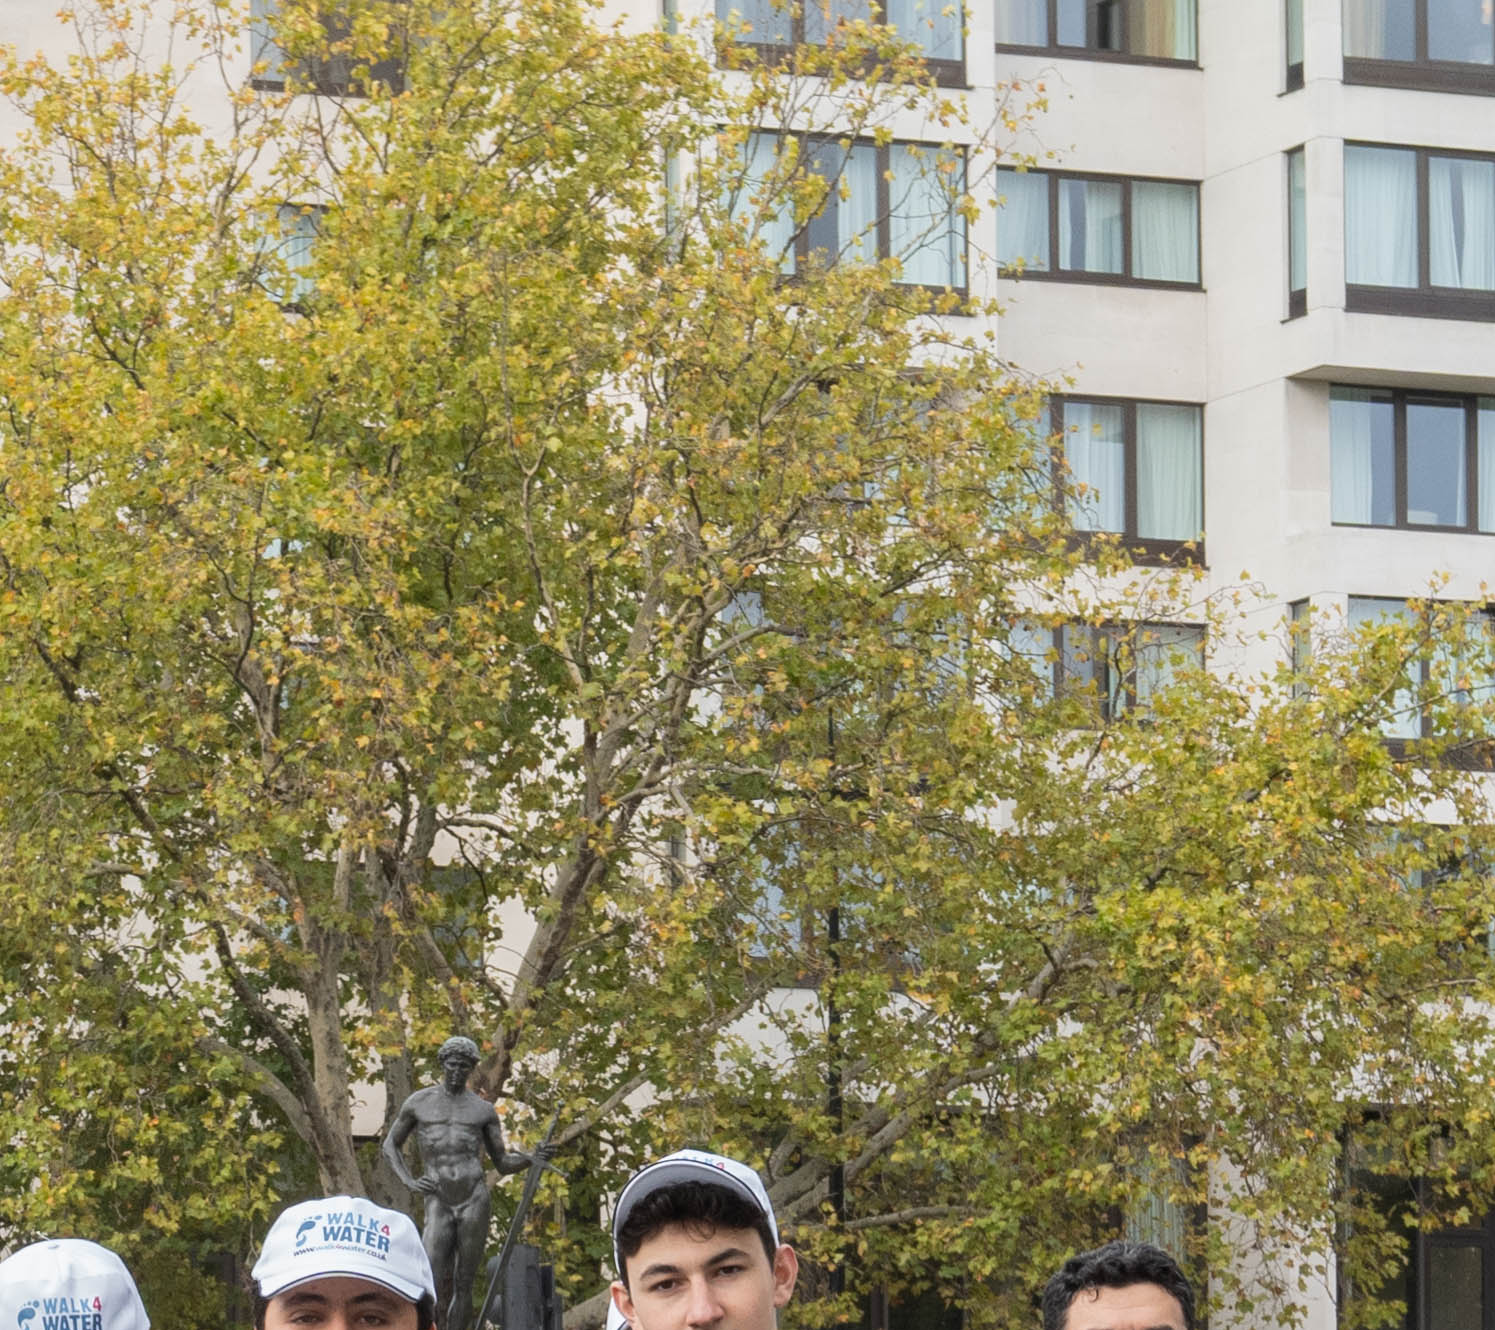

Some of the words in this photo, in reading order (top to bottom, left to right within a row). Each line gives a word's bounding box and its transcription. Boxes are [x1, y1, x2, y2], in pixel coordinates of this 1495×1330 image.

[327, 1212, 390, 1236] WALK4
[322, 1225, 390, 1253] WATER
[43, 1296, 103, 1314] WALK4
